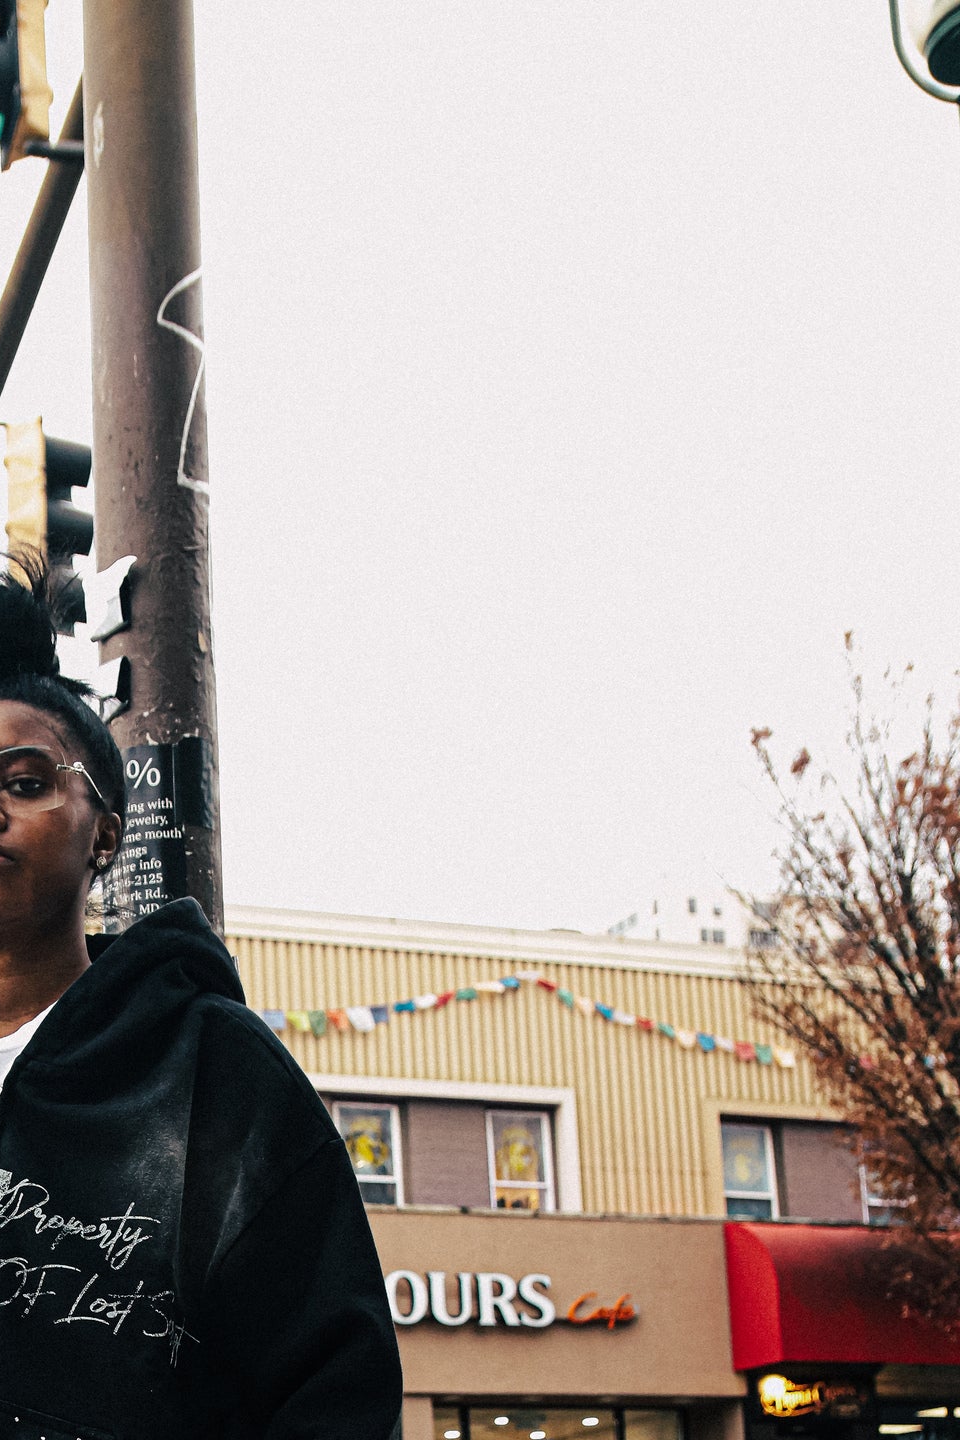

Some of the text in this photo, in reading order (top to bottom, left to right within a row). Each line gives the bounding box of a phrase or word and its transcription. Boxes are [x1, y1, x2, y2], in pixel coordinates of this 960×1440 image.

[126, 797, 173, 814] ing with
[145, 827, 182, 840] mouth
[139, 857, 162, 870] info
[385, 1269, 557, 1328] OURS
